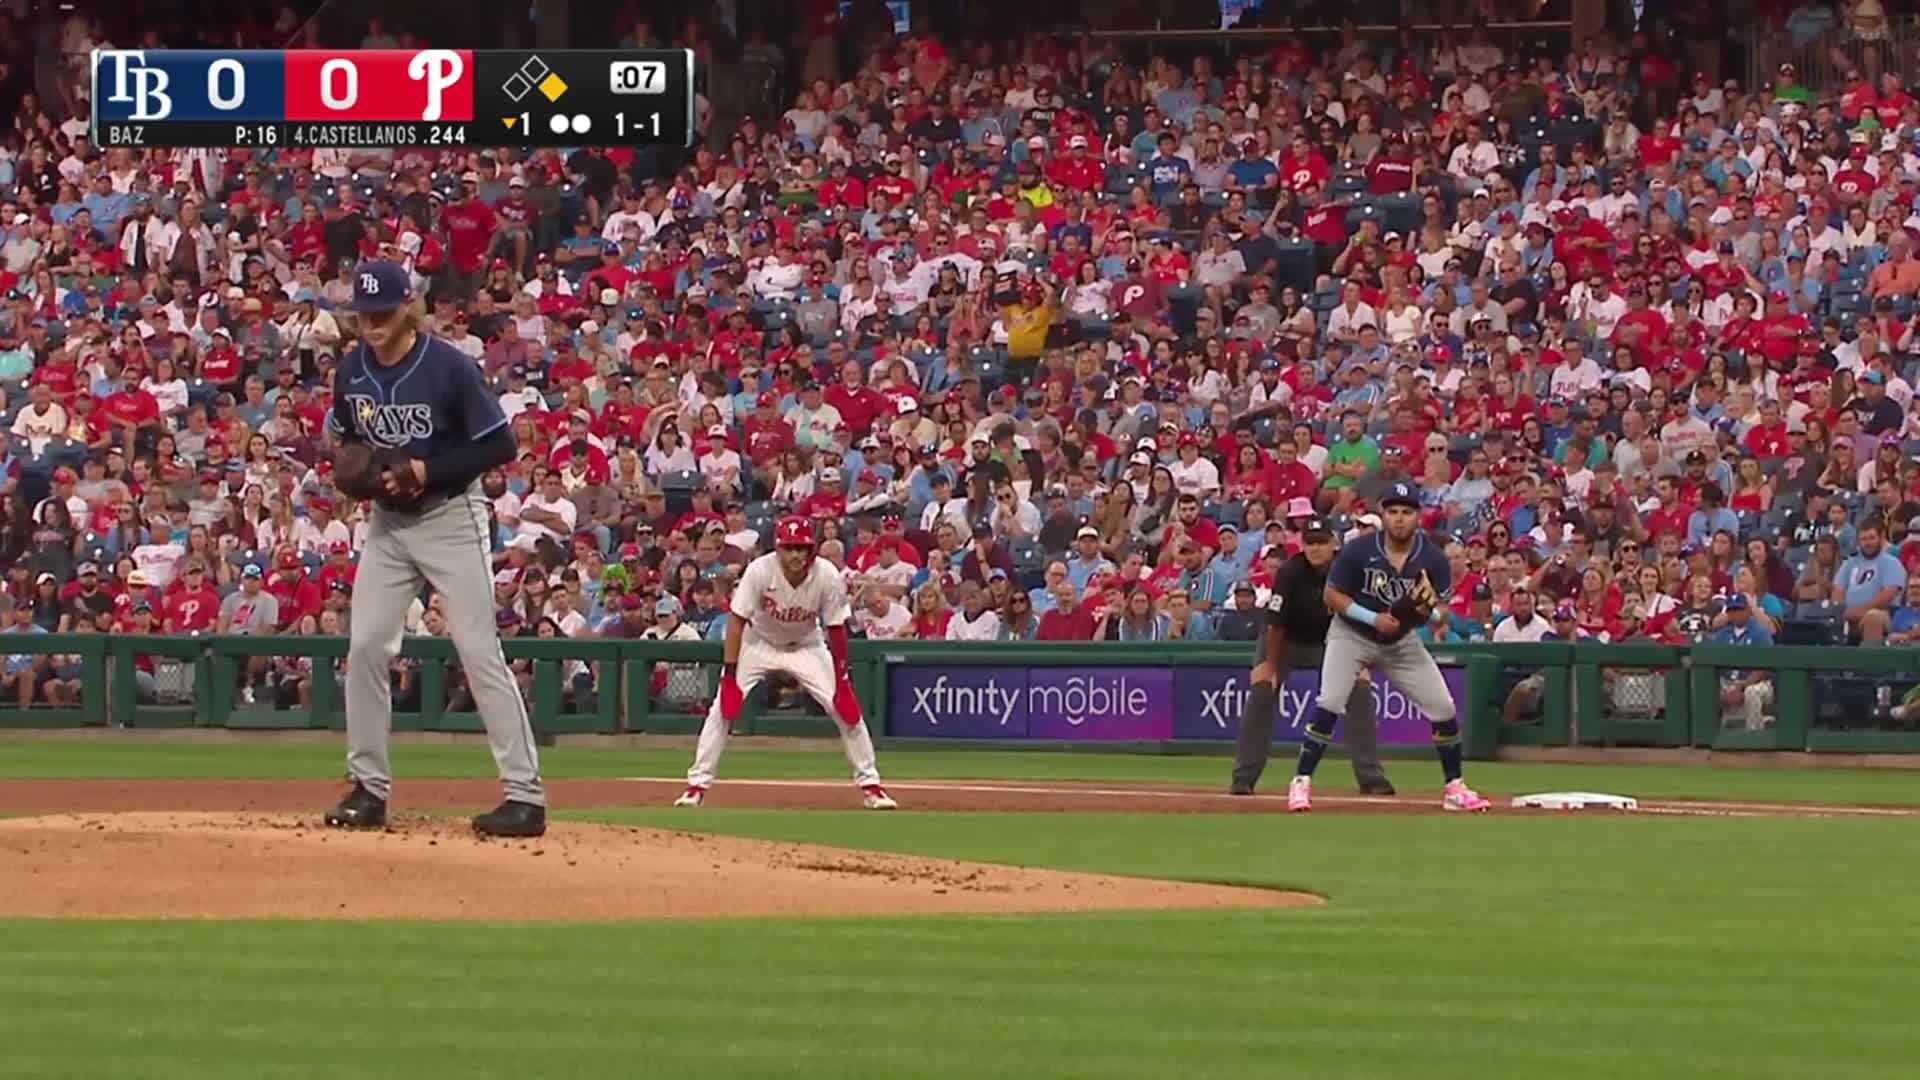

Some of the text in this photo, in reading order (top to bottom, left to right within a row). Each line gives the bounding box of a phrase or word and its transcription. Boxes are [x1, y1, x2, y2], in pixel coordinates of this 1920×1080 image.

[360, 273, 379, 294] TB
[1122, 285, 1144, 306] P
[179, 600, 200, 626] P
[912, 675, 1020, 725] xfinity
[1200, 677, 1312, 728] xfity
